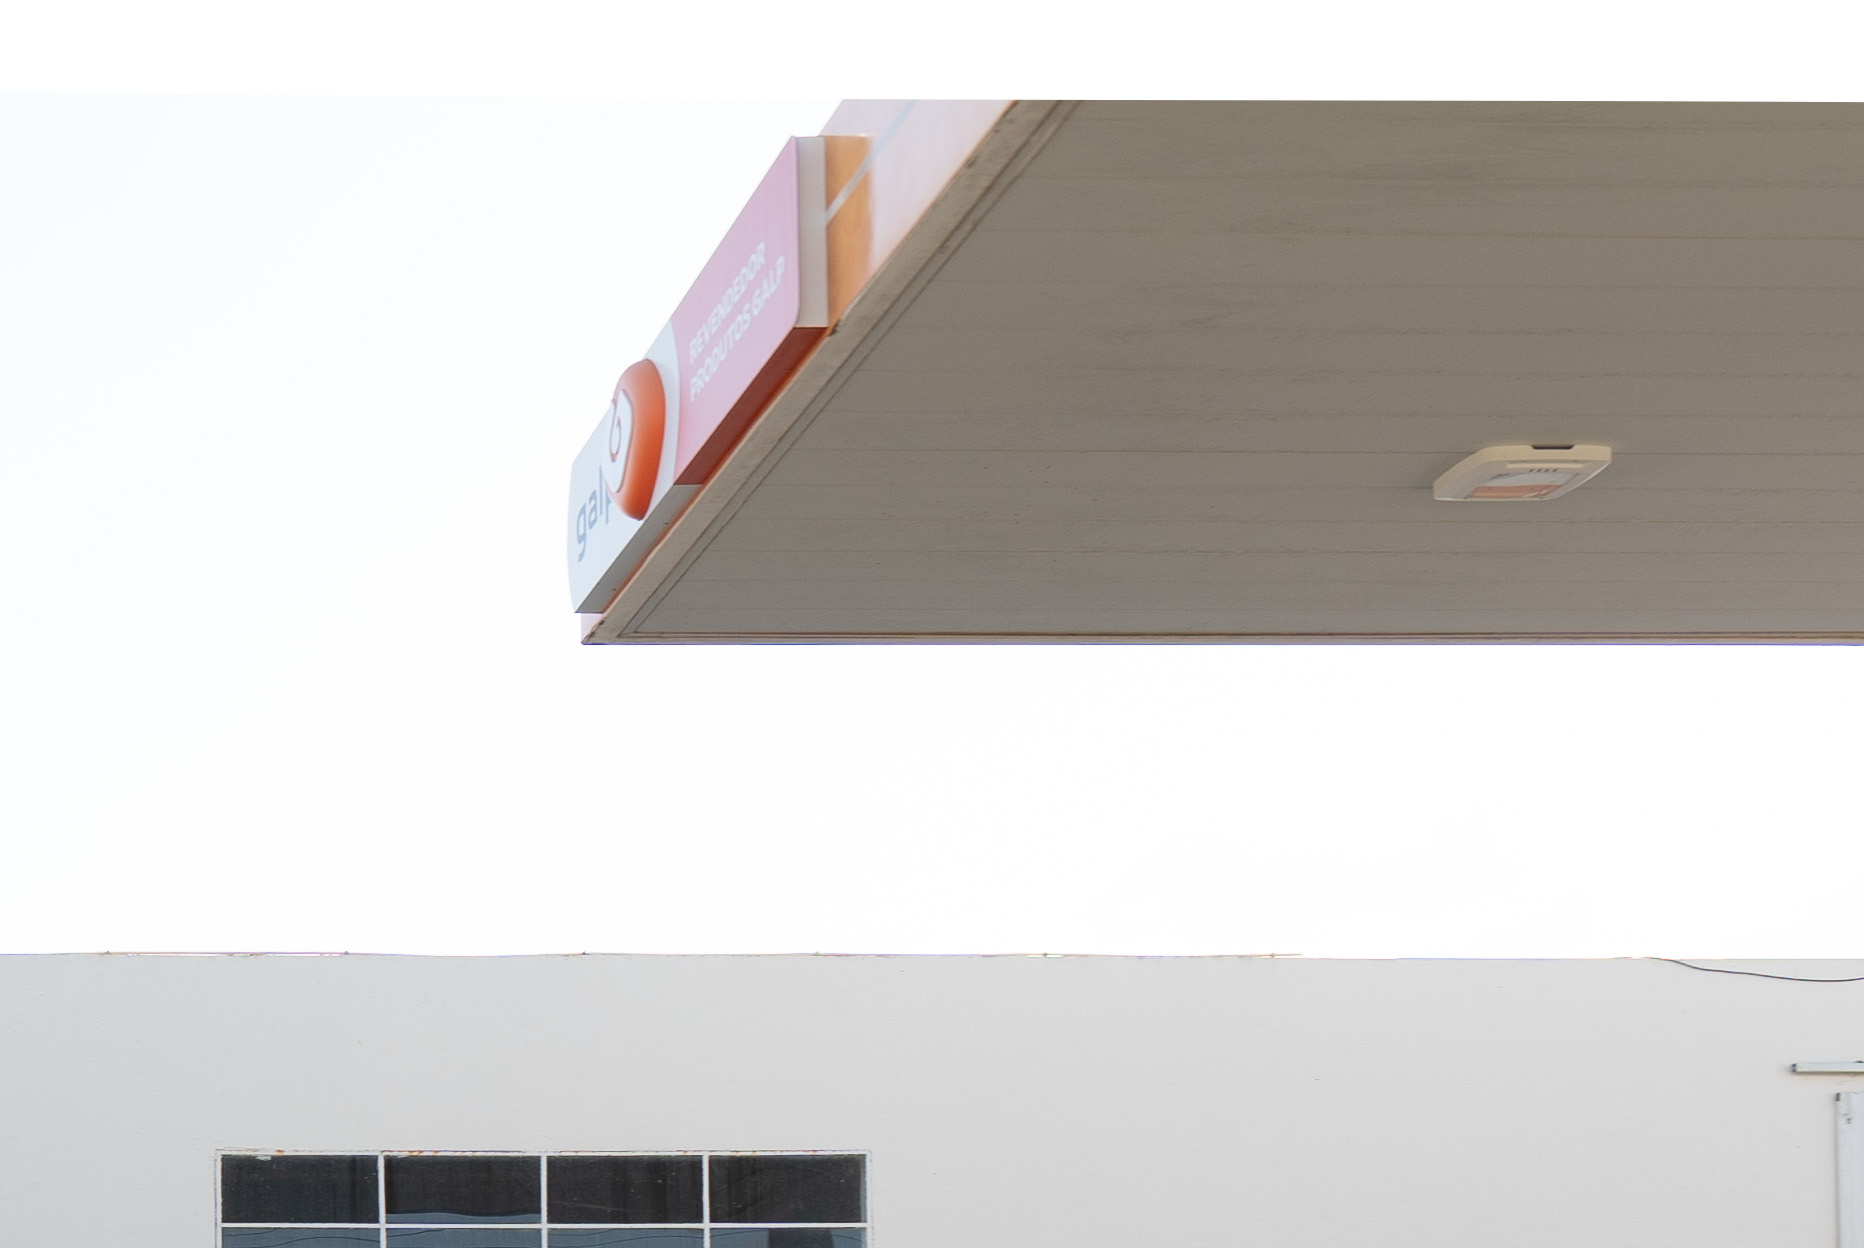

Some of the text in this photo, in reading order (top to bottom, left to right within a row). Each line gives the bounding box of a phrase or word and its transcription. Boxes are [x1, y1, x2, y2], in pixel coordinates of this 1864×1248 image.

[688, 242, 767, 364] REVENDEDOR
[688, 255, 787, 403] PRODUTOS GALP
